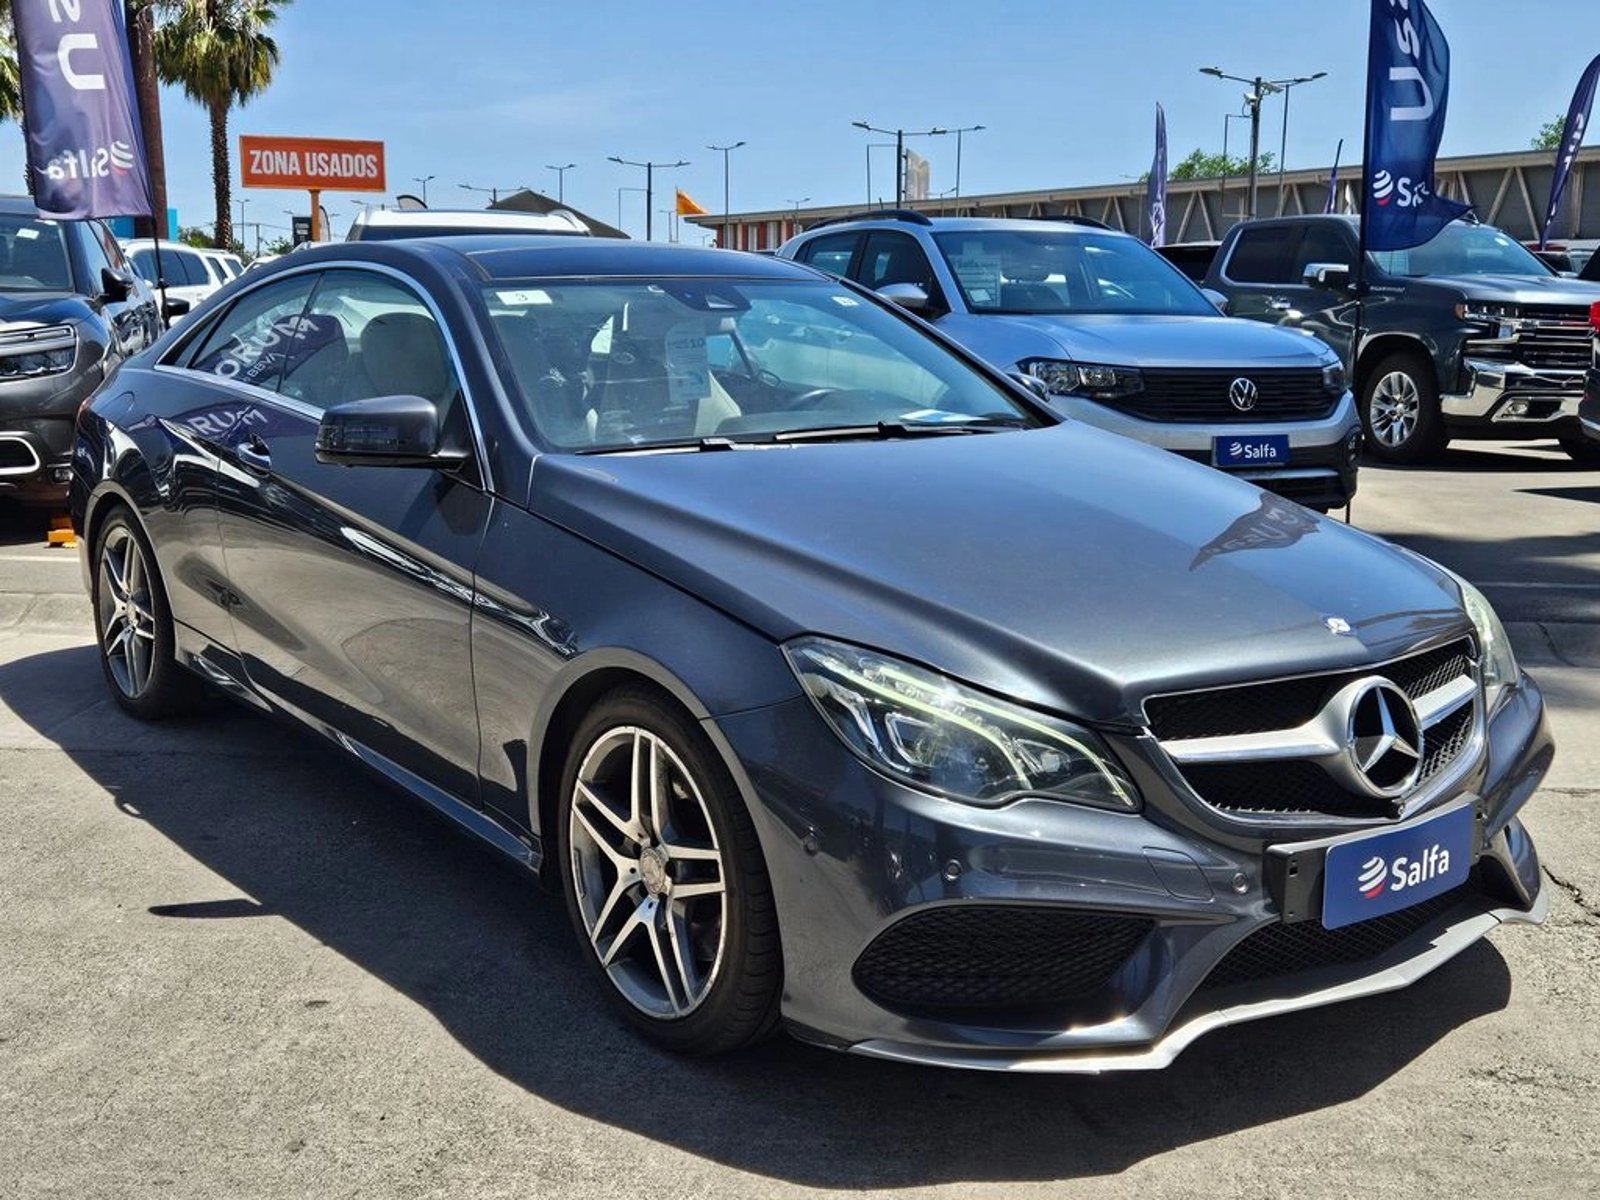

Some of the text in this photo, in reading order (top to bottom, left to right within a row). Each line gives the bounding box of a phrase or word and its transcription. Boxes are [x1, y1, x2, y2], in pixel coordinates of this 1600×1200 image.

[1389, 0, 1434, 121] Us
[250, 150, 378, 178] ZONA USADOS
[1244, 443, 1277, 459] Salfa
[1390, 844, 1449, 891] Salfa
